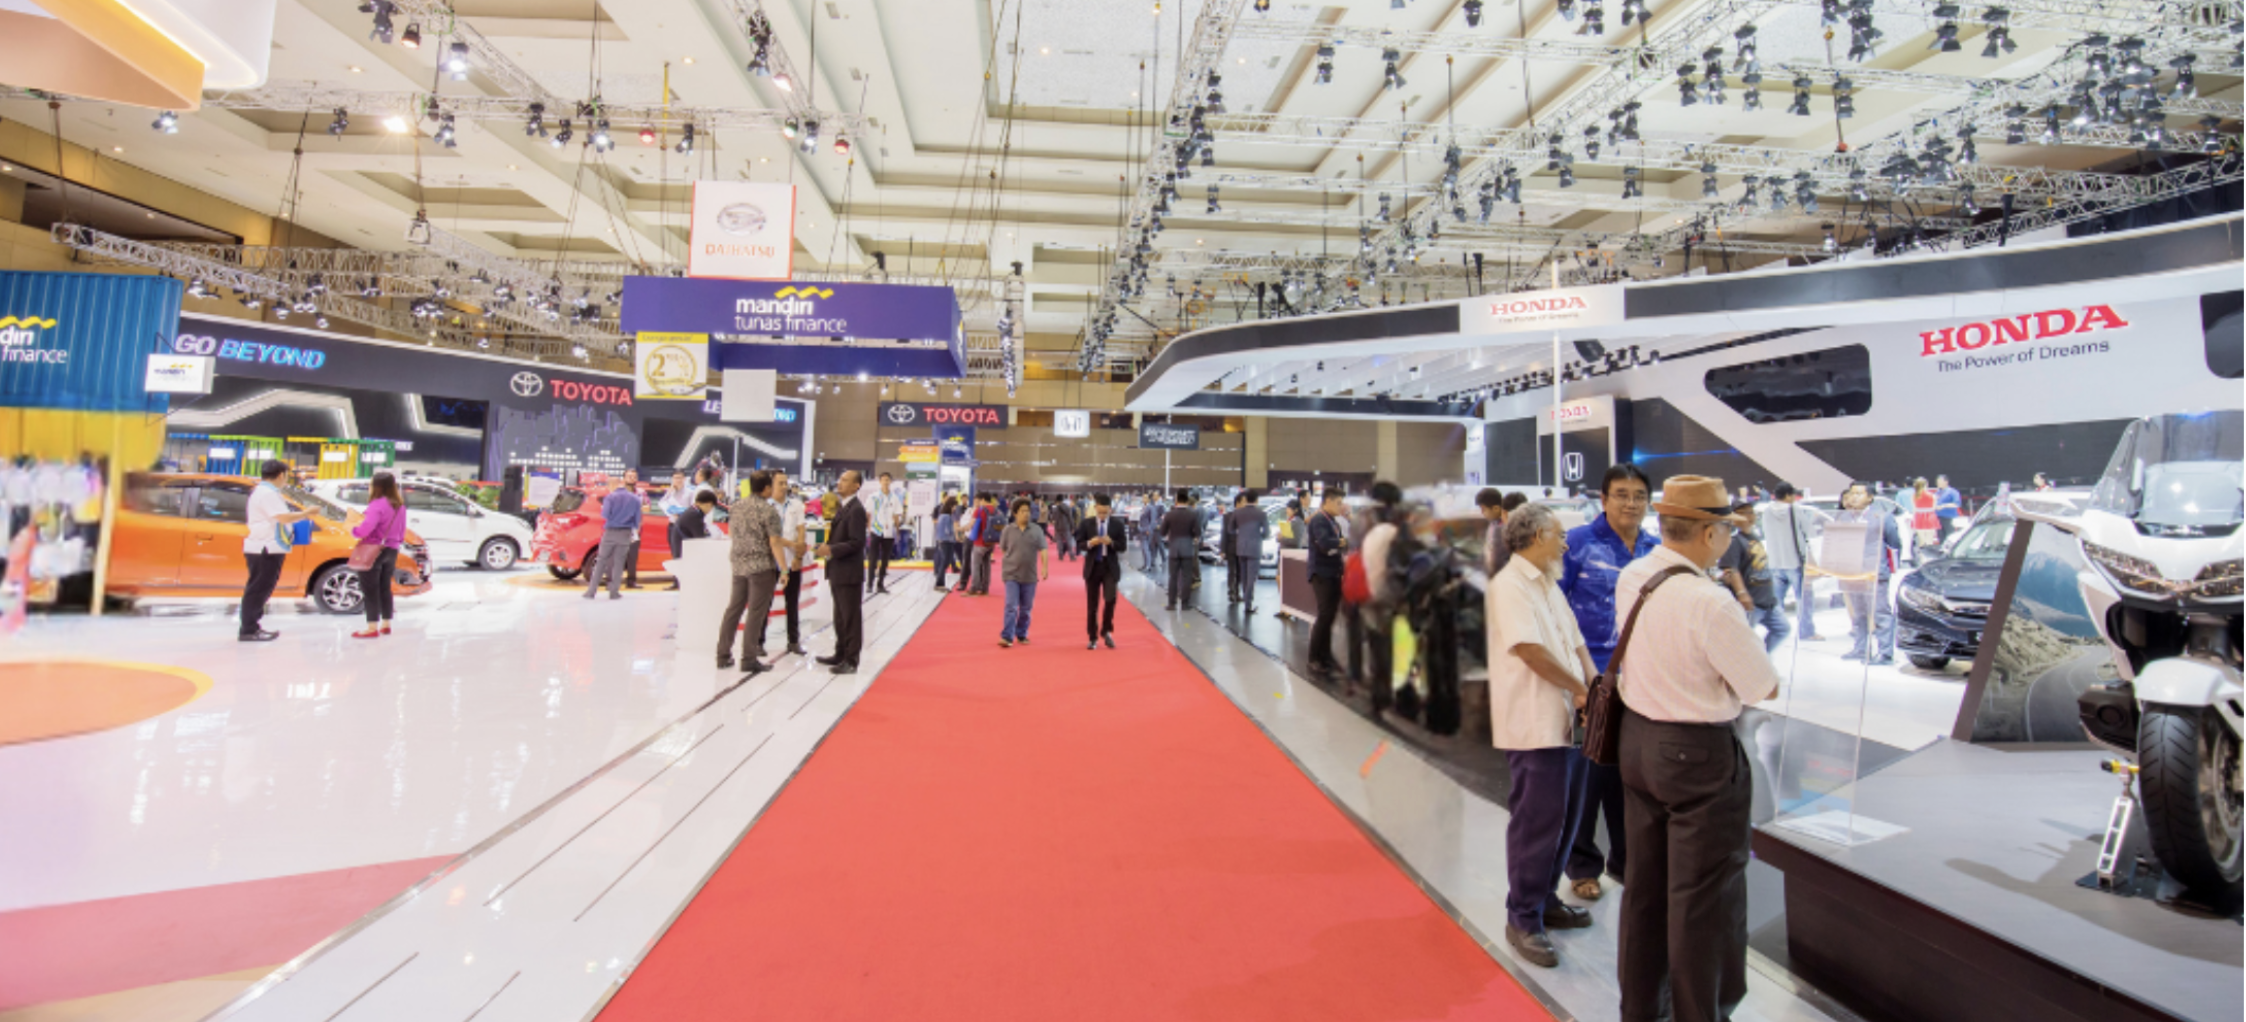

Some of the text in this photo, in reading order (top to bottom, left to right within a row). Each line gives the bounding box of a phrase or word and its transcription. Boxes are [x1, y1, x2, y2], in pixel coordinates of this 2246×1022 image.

[705, 243, 775, 258] DAIHATSU
[736, 294, 814, 318] mandiri
[1490, 296, 1587, 315] HONDA
[734, 313, 848, 333] tunas finance
[1919, 304, 2129, 357] HONDA
[175, 333, 326, 369] GO BEYOND
[1937, 340, 2110, 373] The Power of Dreams
[550, 379, 633, 406] TOYOTA
[923, 407, 999, 424] TOYOTA
